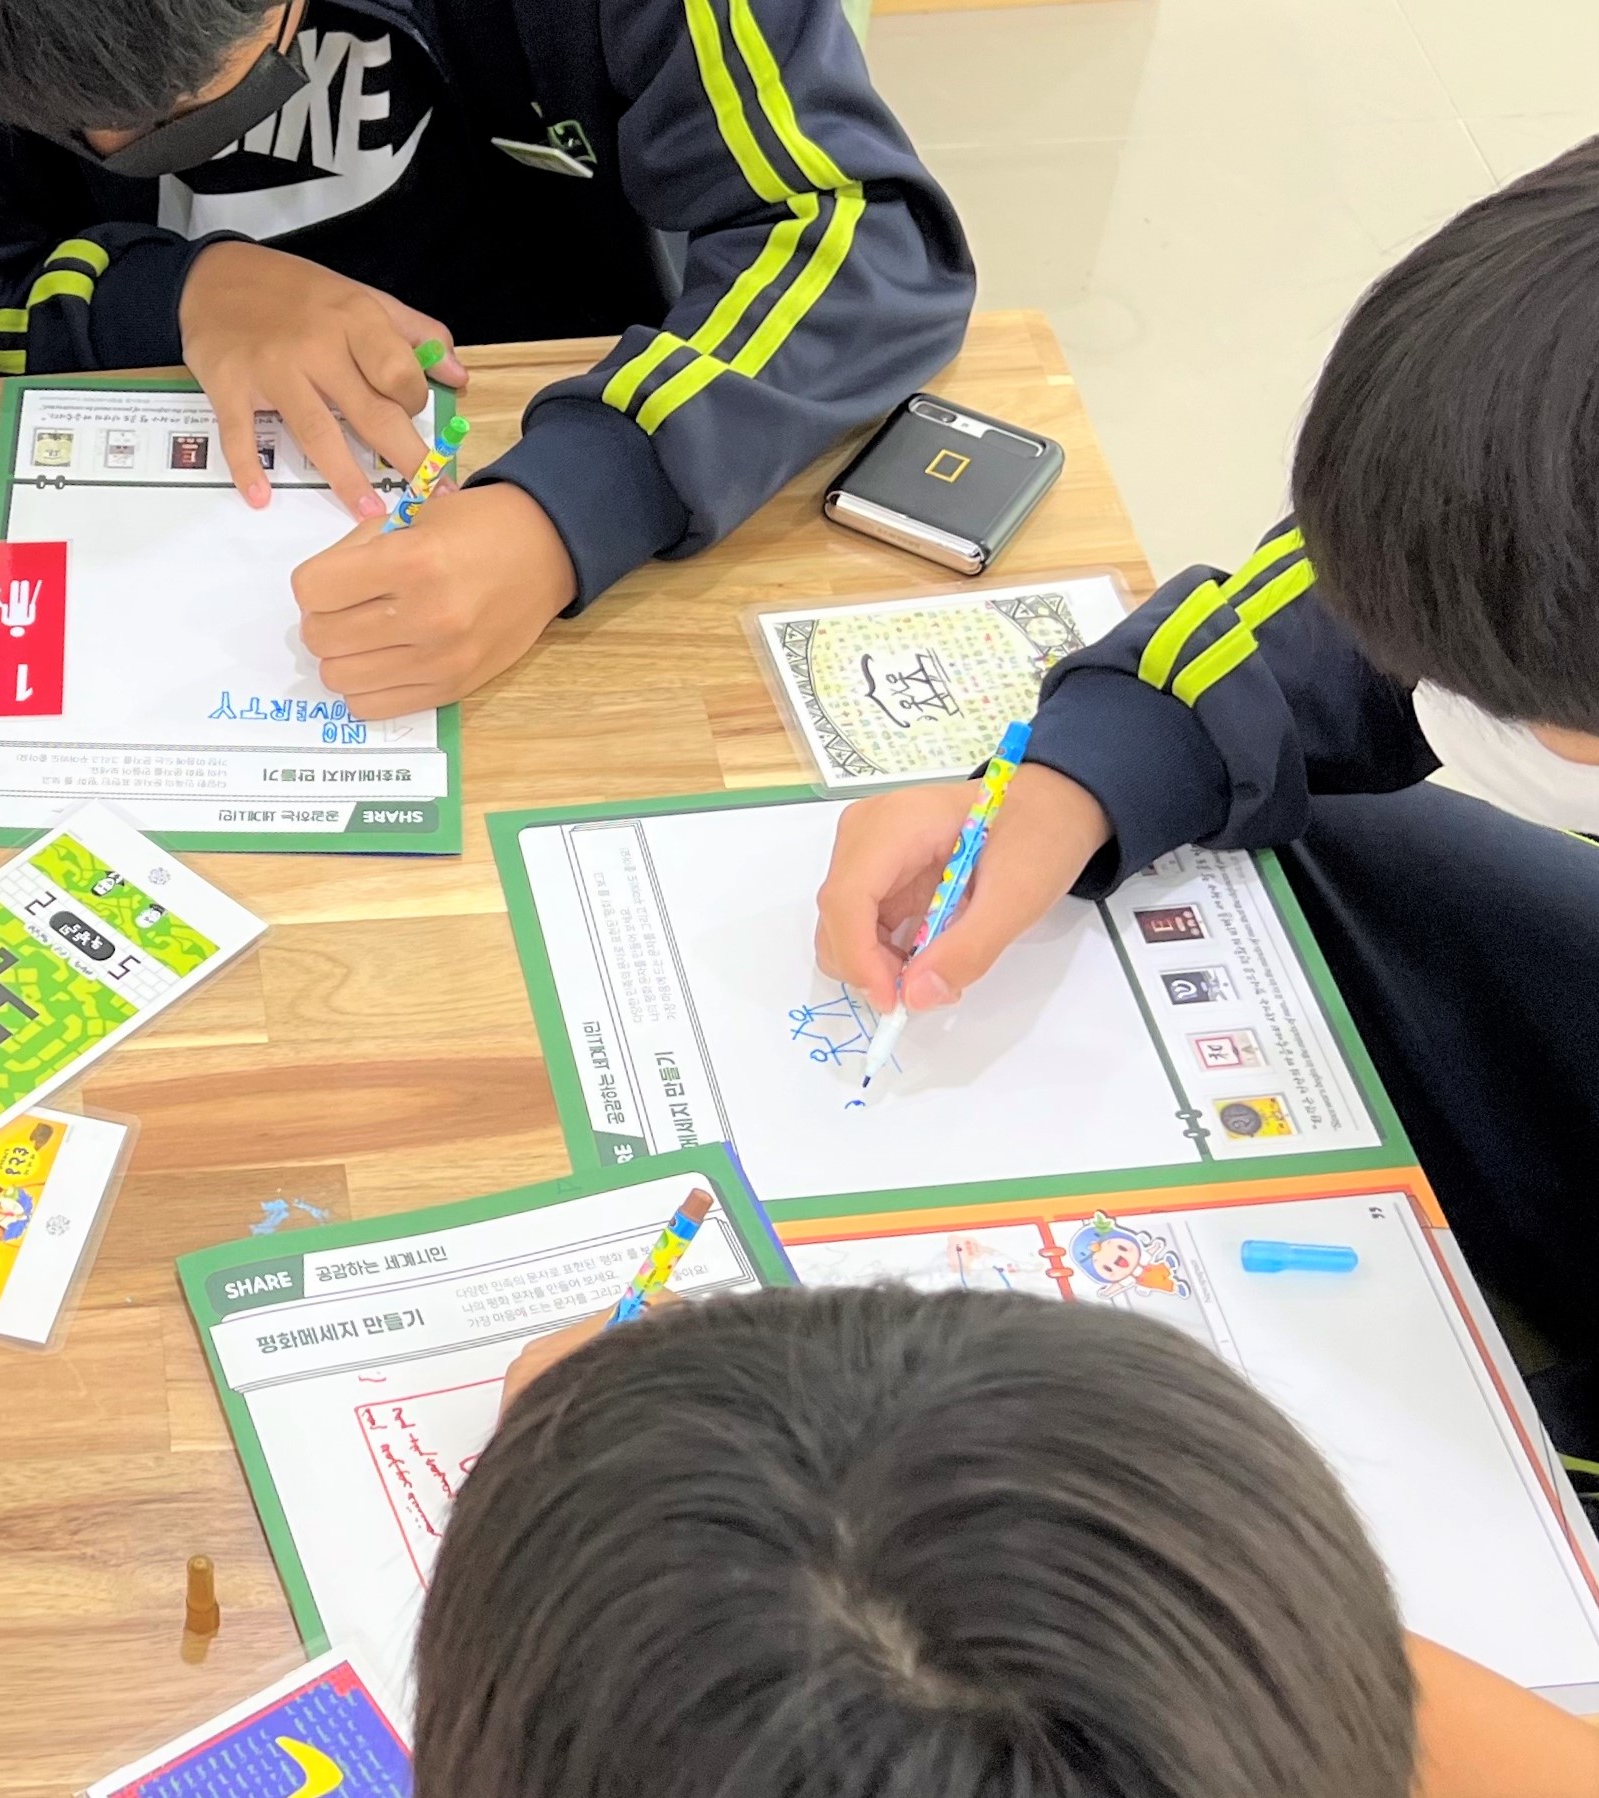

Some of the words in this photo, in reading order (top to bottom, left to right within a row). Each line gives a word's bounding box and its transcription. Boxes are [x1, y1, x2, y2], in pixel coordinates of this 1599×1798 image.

[14, 663, 34, 702] 1
[321, 723, 367, 745] NO
[263, 769, 316, 782] 만들기
[321, 769, 412, 782] 평화메세지
[218, 809, 277, 822] 세계시민
[281, 810, 340, 822] 공감하는
[362, 810, 424, 823] SHARE
[582, 1021, 610, 1070] 세계시민
[654, 1050, 685, 1098] 만들기
[595, 1073, 625, 1125] 공감하는
[315, 1259, 381, 1282] 공감하는
[384, 1245, 448, 1271] 세계시민
[224, 1270, 293, 1300] SHARE
[256, 1320, 359, 1354] 평화메세지
[362, 1308, 425, 1335] 만들기
